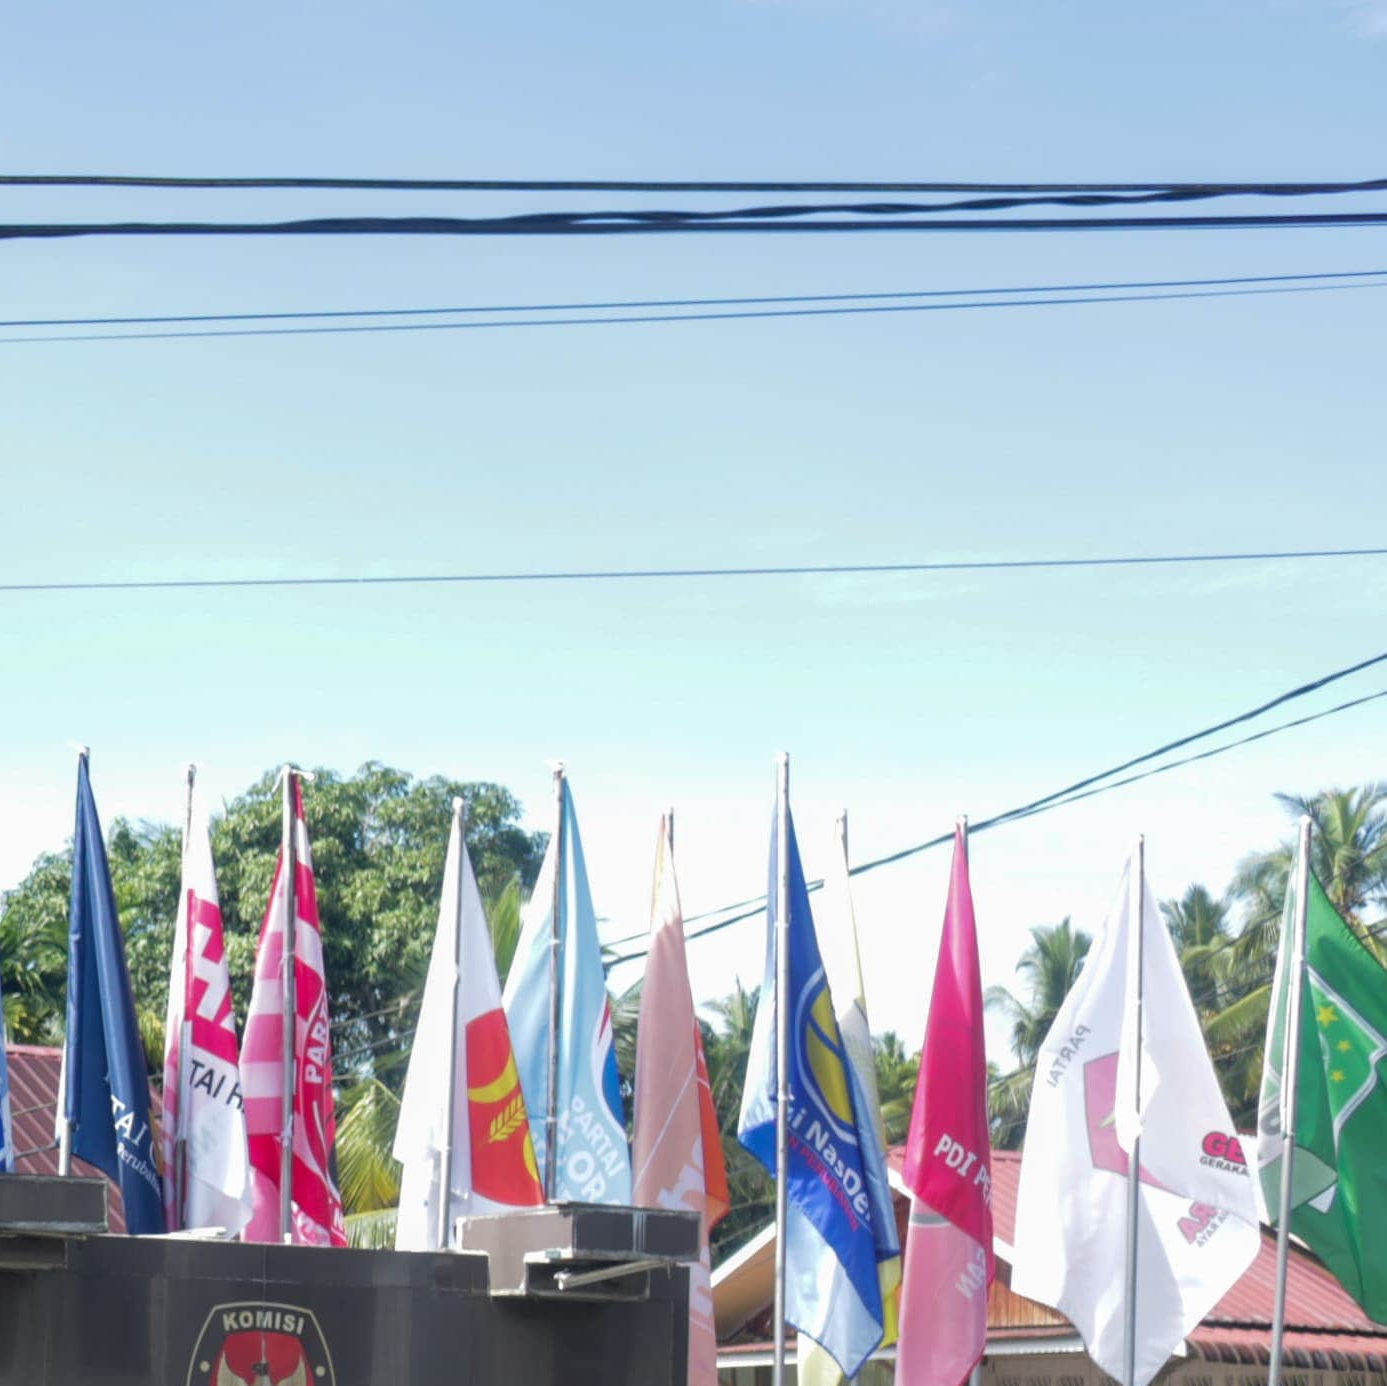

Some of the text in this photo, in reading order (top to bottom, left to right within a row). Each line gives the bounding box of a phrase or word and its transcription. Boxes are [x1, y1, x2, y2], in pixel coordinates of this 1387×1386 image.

[571, 1096, 626, 1177] PARTAI
[934, 1133, 977, 1177] PDI
[805, 1120, 870, 1221] NasDe
[1200, 1156, 1249, 1177] GERAKA
[222, 1310, 305, 1335] KOMISI
